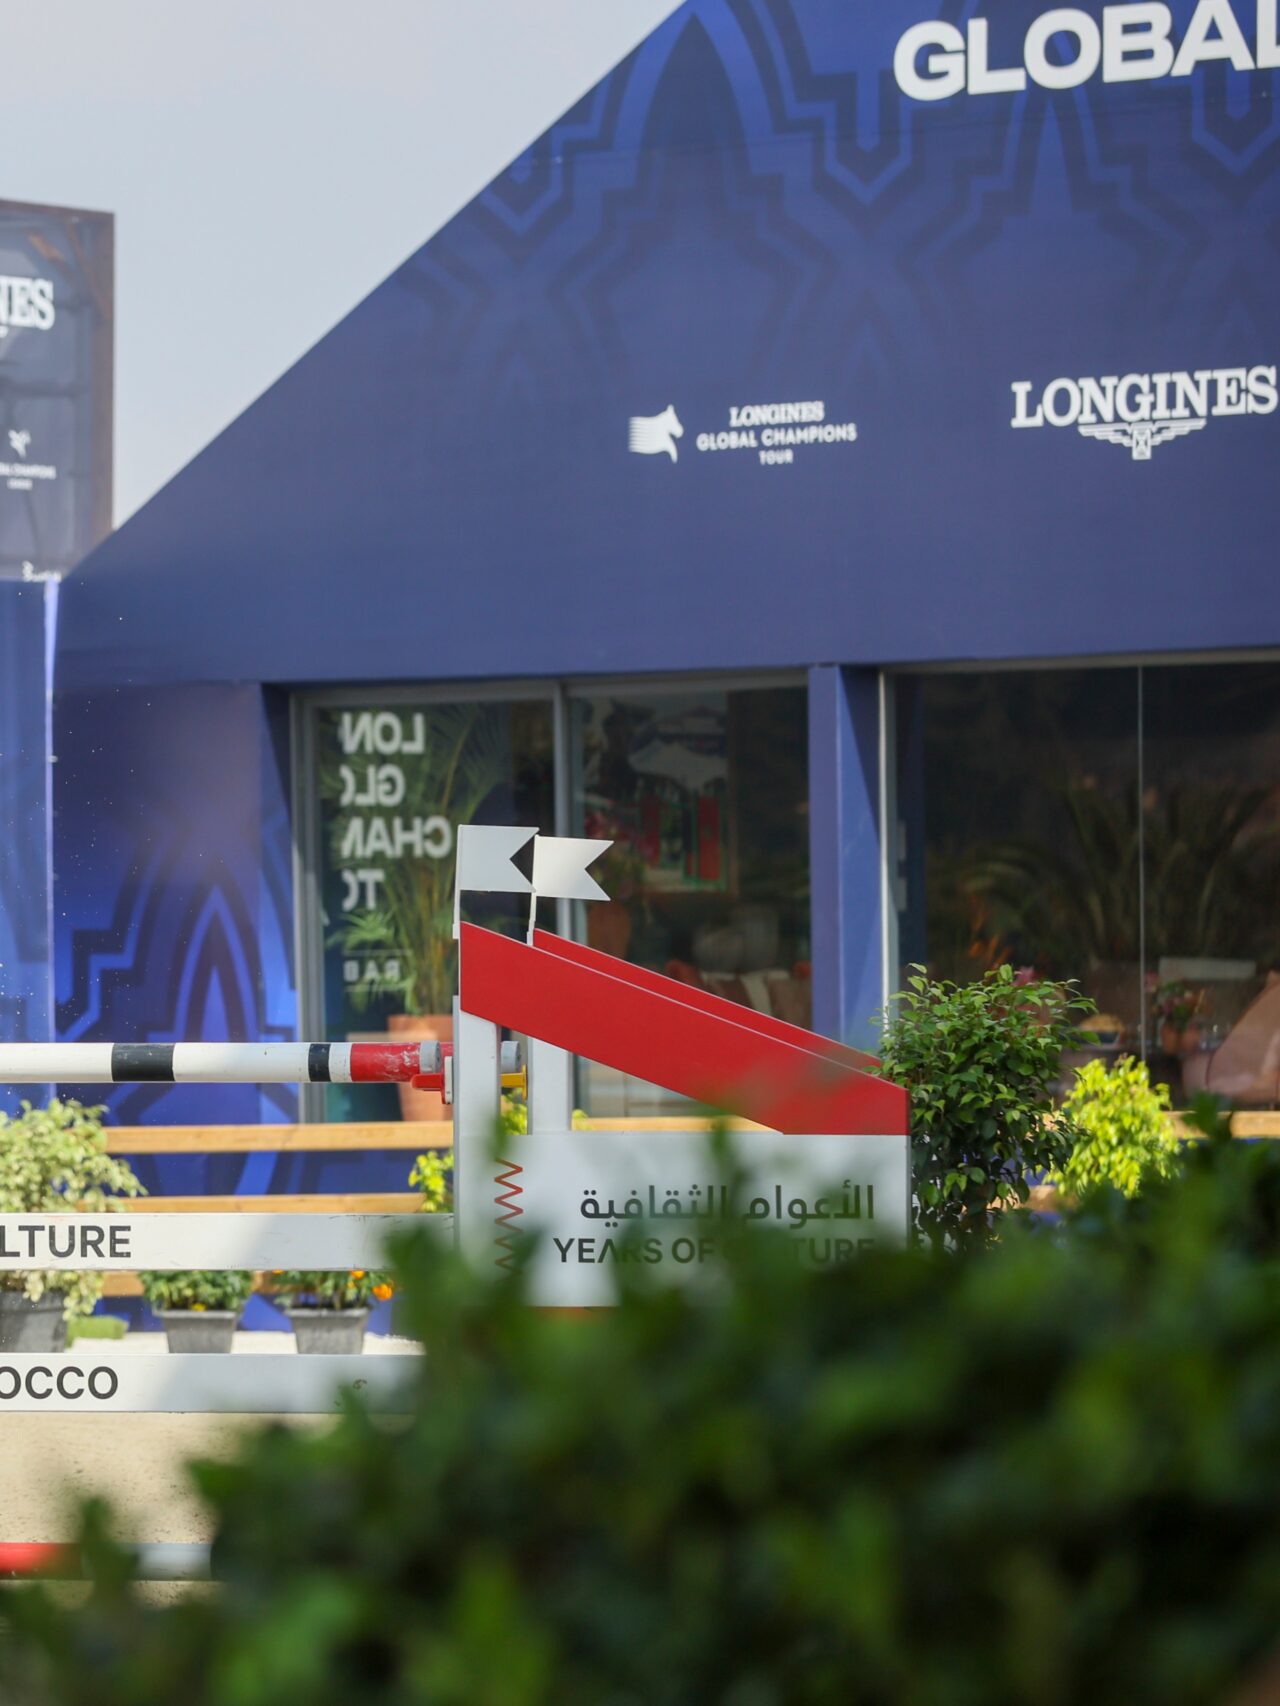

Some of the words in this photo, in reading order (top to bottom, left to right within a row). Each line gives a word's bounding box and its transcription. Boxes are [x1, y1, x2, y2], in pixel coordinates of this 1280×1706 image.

[894, 0, 1280, 101] GLOBAL
[1011, 366, 1278, 428] LONGINES
[729, 401, 824, 427] LONGINES
[696, 430, 758, 451] GLOBAL
[761, 423, 857, 446] CHAMPIONS
[759, 449, 793, 465] TOUR
[671, 1238, 715, 1264] OF
